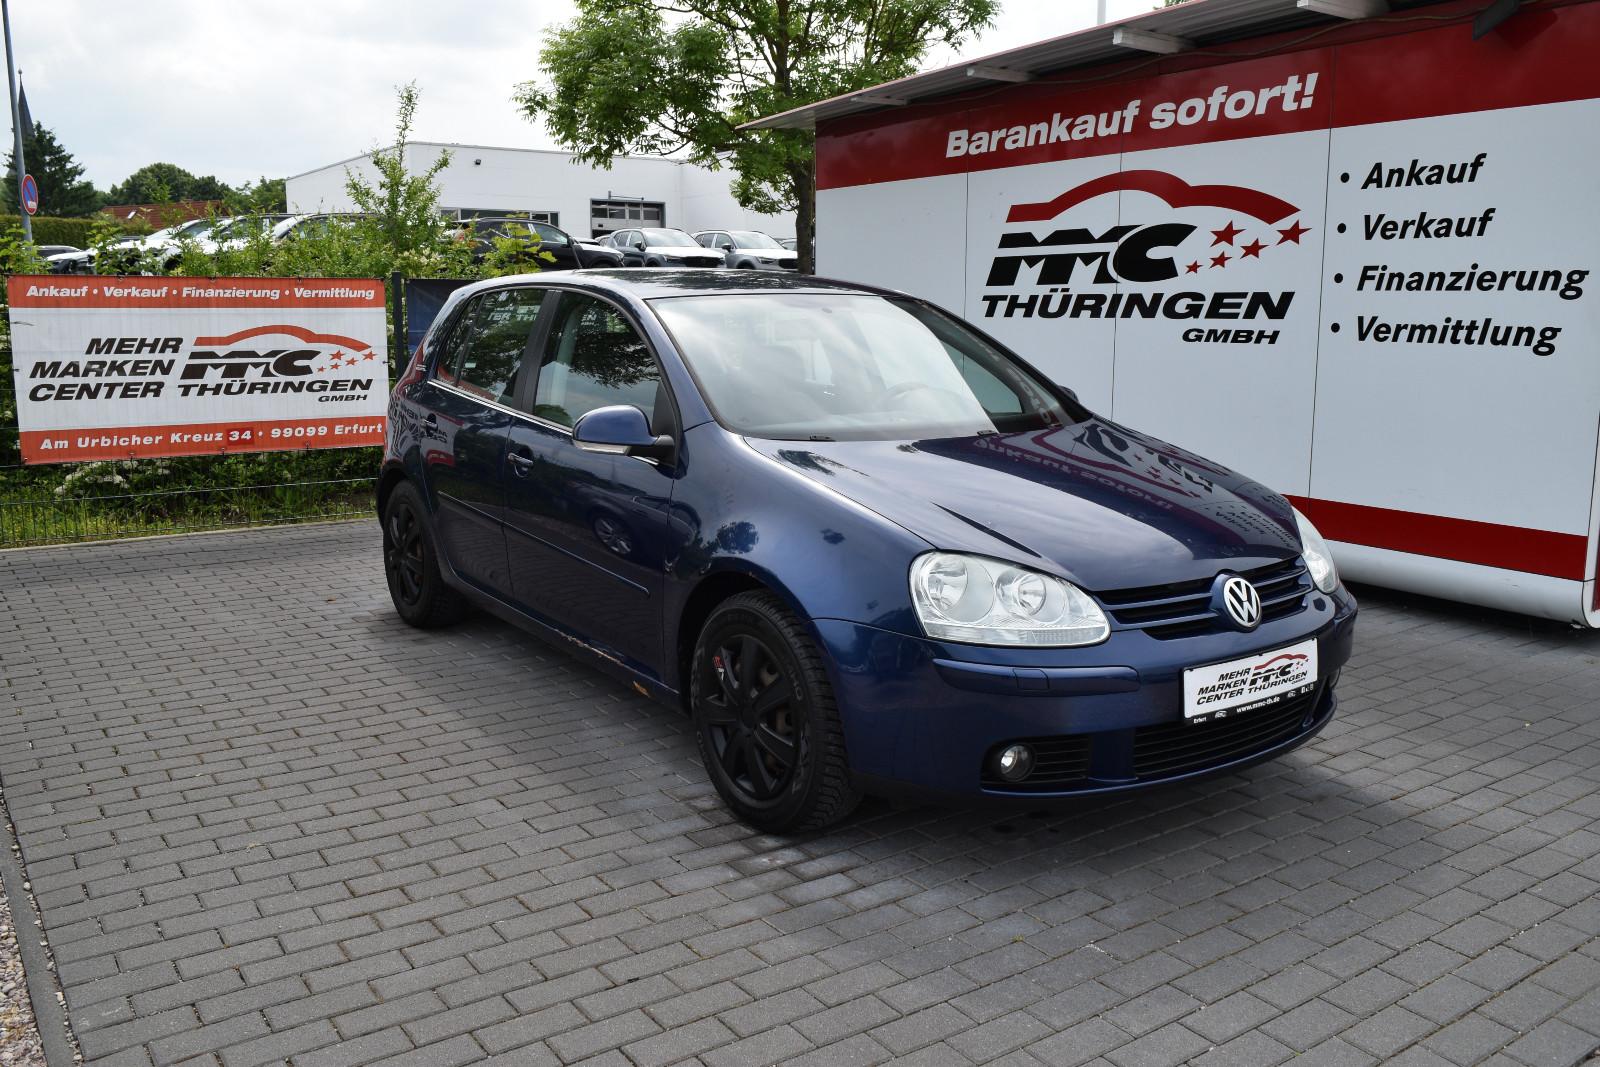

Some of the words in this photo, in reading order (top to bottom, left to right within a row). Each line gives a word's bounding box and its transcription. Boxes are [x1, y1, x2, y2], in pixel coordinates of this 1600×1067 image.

[945, 99, 1141, 159] Barankauf
[1149, 72, 1319, 130] sofort!
[1361, 152, 1487, 190] Ankauf
[1364, 207, 1496, 241] Verkauf
[26, 285, 88, 297] Ankauf
[103, 286, 169, 298] Verkauf
[182, 286, 280, 300] Finanzierung
[293, 287, 375, 300] Vermittlung
[1356, 263, 1589, 300] Finanzierung
[982, 287, 1295, 320] THÜRINGEN
[85, 337, 183, 355] MEHR
[1182, 327, 1280, 345] GMBH
[1356, 315, 1562, 356] Vermittlung
[29, 358, 175, 379] MARKEN
[29, 381, 165, 402] CENTER
[178, 378, 373, 397] THÜRINGEN
[318, 394, 368, 403] GMBH
[40, 438, 69, 450] Am
[77, 434, 163, 448] Urbicher
[170, 431, 223, 444] Kreuz
[228, 430, 252, 441] 34
[271, 426, 328, 438] 99099
[334, 423, 383, 435] Erfurt
[1197, 677, 1249, 696] MARKEN
[1217, 667, 1252, 682] MEHR
[1196, 688, 1245, 706] CENTER
[1247, 670, 1308, 694] THÜRINGEN
